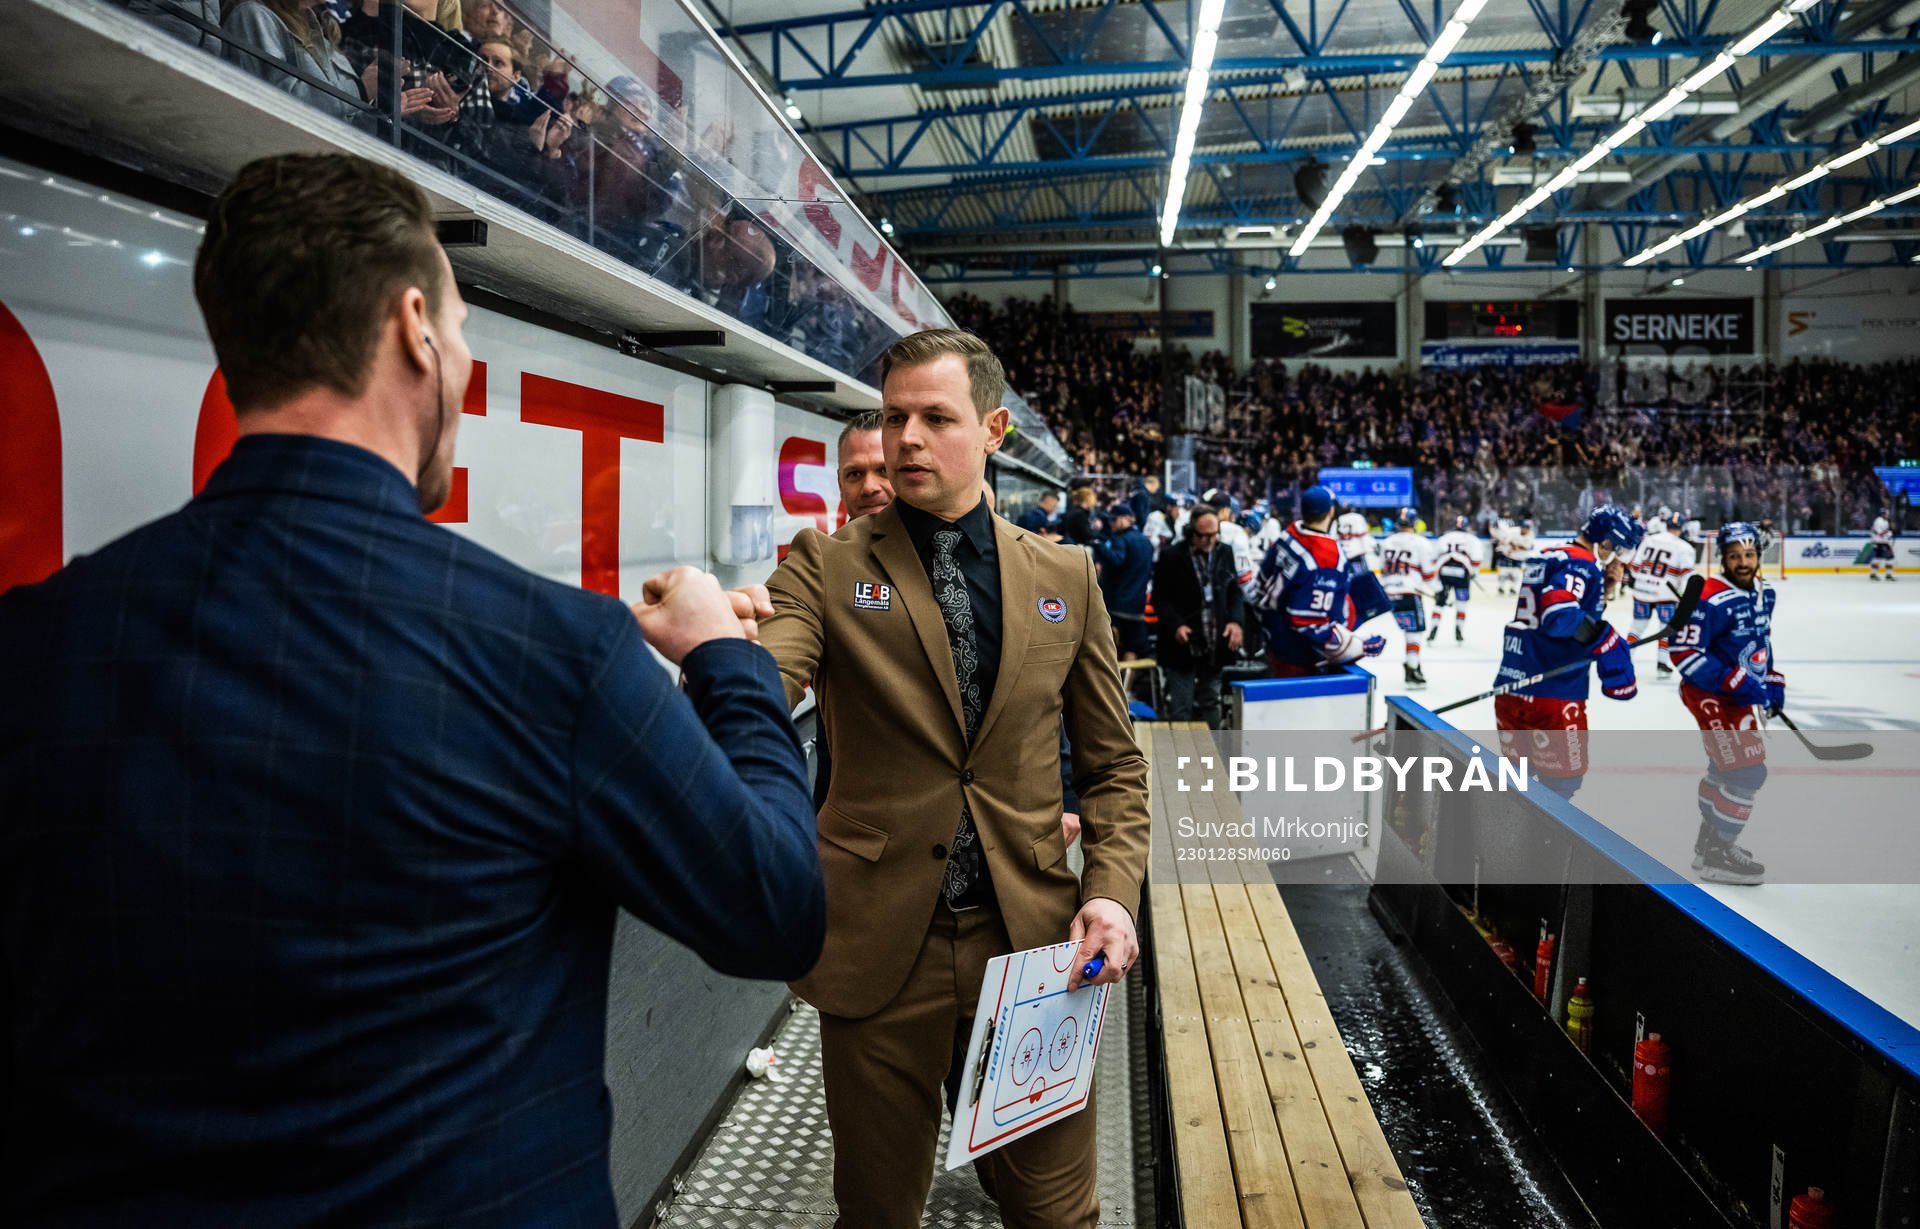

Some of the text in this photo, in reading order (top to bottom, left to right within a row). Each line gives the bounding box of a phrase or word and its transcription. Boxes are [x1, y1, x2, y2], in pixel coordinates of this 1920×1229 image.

[1613, 314, 1740, 341] SERNEKE
[855, 582, 890, 600] LEAB
[1310, 589, 1335, 611] 30
[1564, 573, 1586, 600] 13
[989, 1005, 1009, 1082] BAUER
